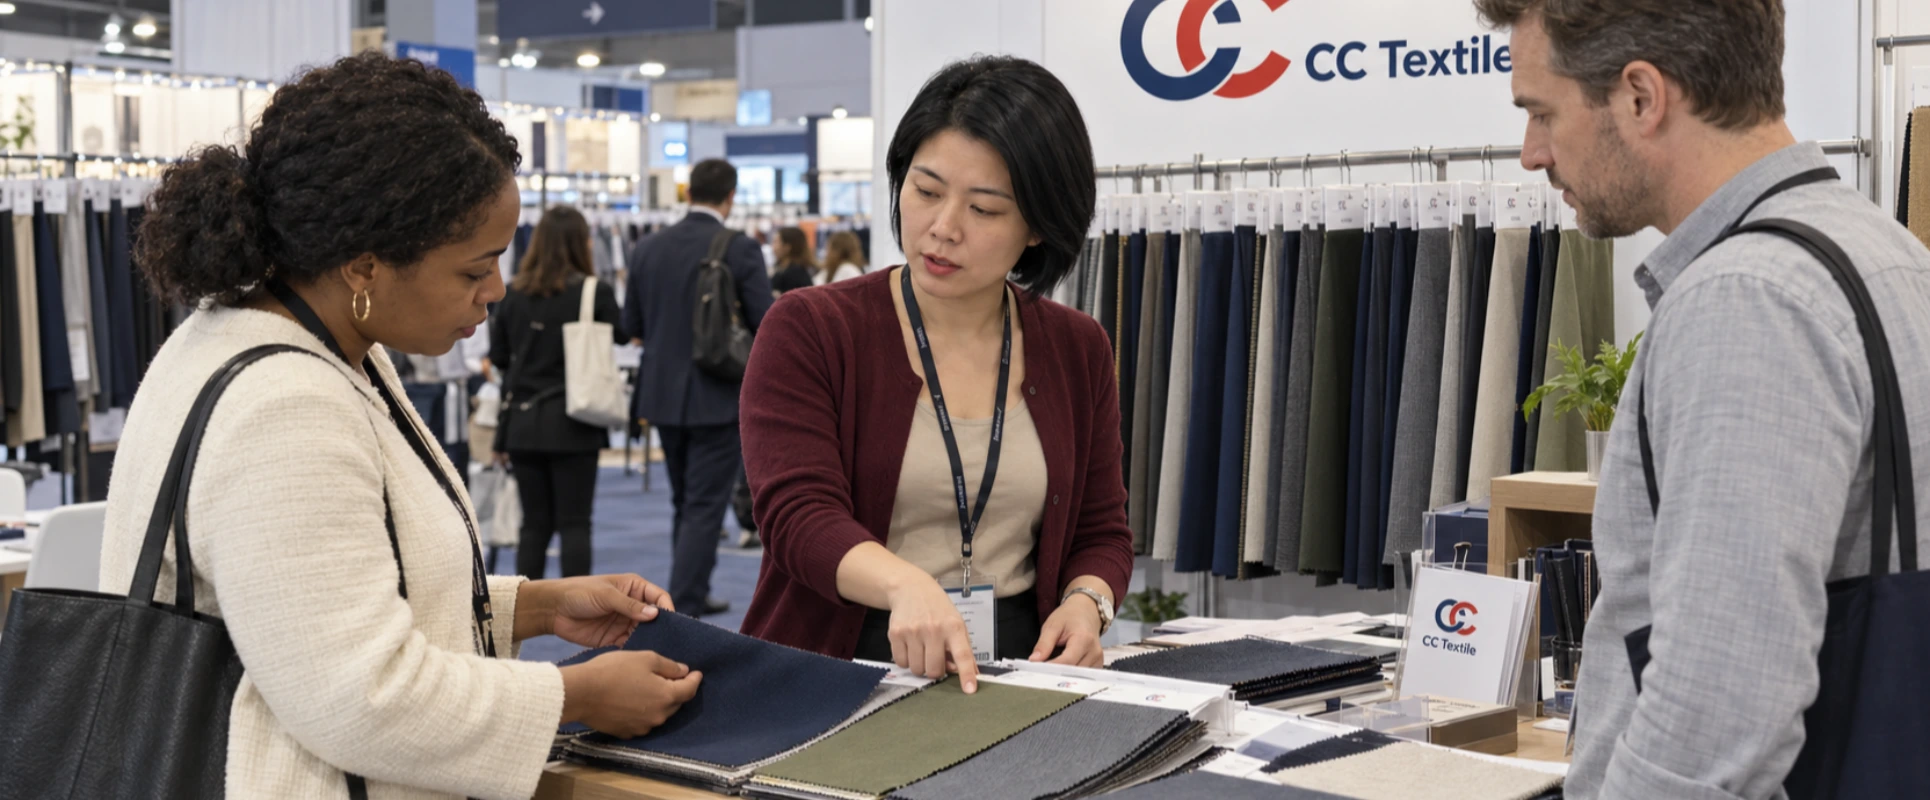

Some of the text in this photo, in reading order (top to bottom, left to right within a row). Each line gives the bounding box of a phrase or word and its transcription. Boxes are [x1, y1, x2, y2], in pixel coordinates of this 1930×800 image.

[1305, 34, 1513, 82] CC Textile
[1422, 635, 1477, 656] CC Textile
